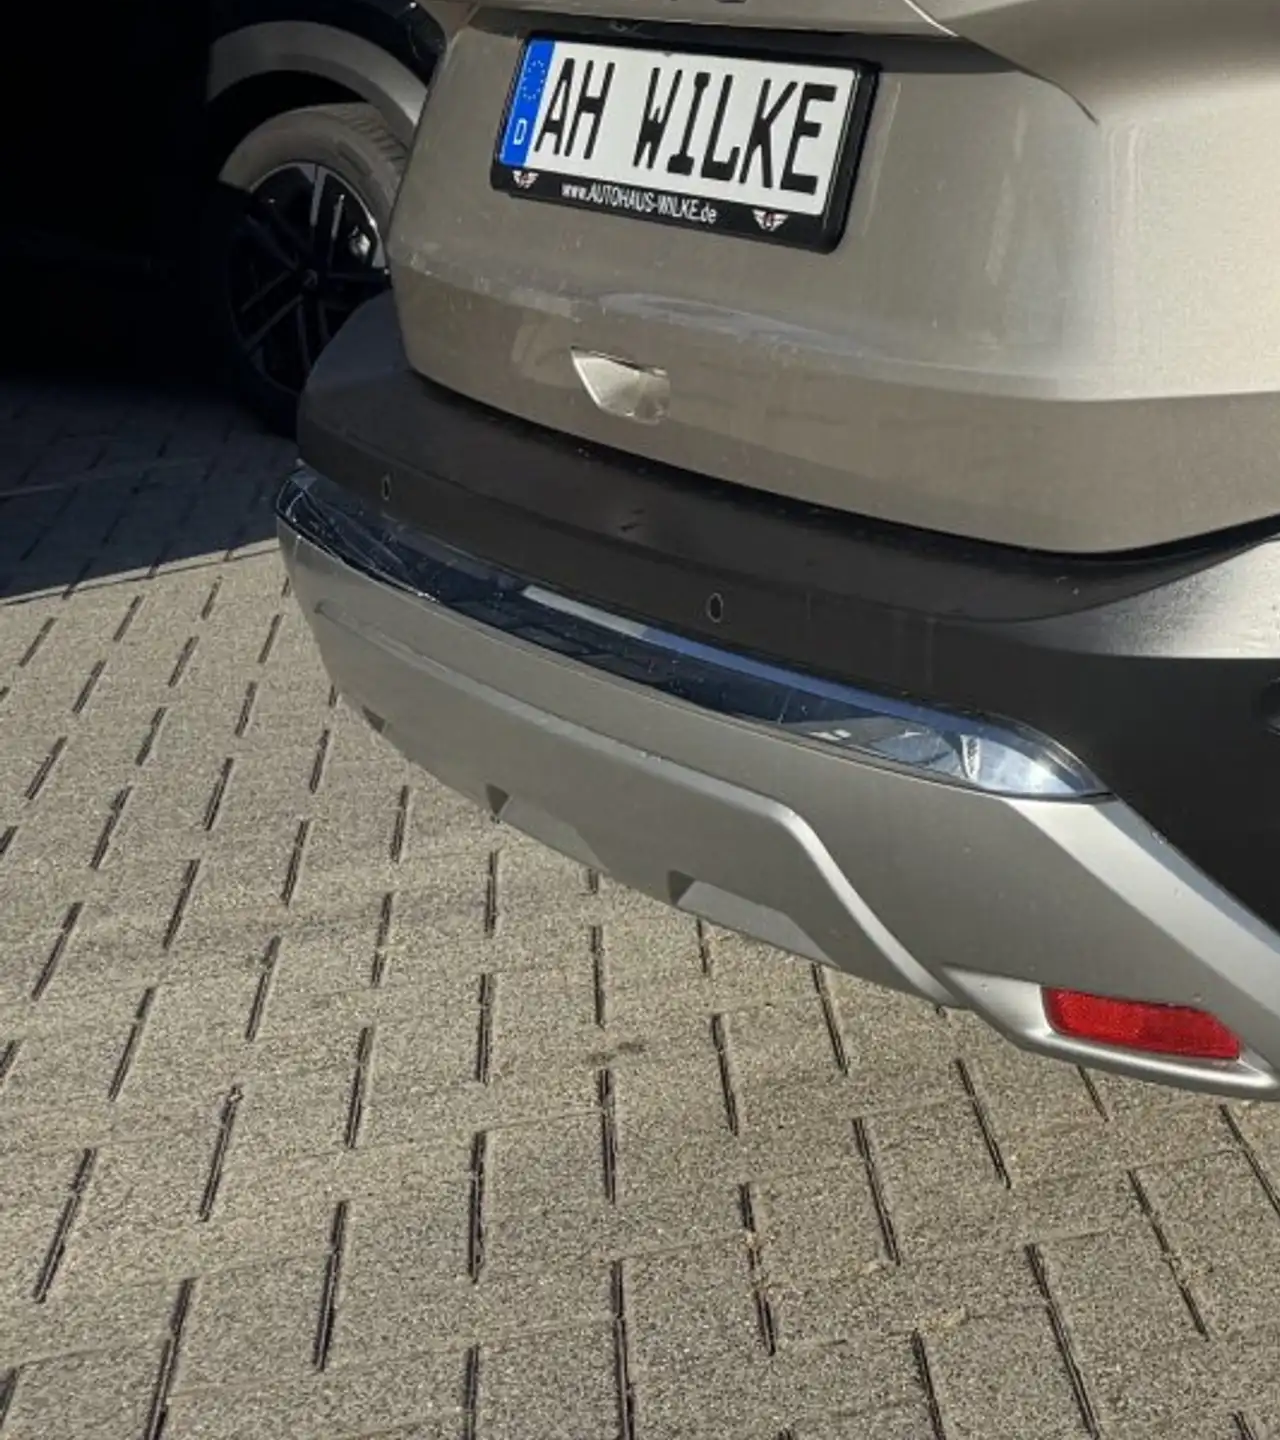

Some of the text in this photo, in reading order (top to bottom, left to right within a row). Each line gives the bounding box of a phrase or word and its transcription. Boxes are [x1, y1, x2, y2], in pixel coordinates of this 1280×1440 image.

[513, 118, 528, 146] D
[533, 57, 837, 196] AH WILKE
[561, 182, 718, 225] www.AUTOHAUS-WILKE.de
